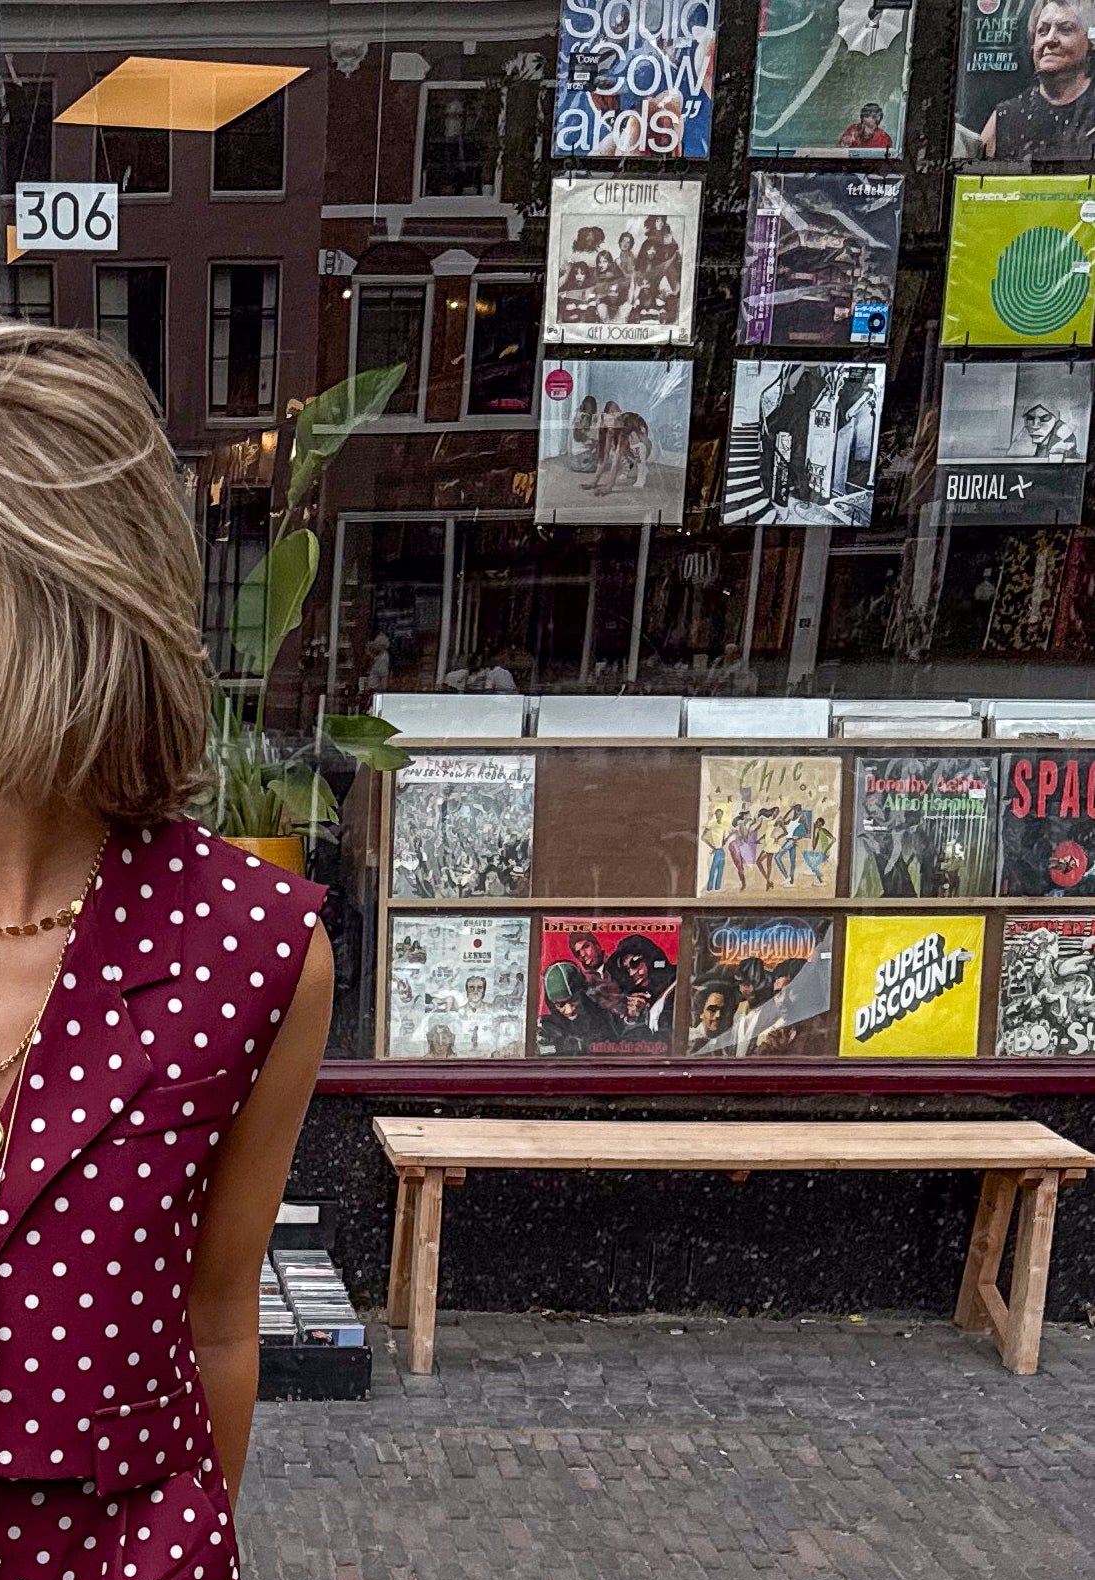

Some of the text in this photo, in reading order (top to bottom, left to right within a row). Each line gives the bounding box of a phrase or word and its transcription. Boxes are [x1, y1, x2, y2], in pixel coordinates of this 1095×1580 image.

[23, 191, 112, 241] 306
[594, 182, 658, 212] CHEYENNE
[946, 474, 1007, 500] BURIAL
[545, 923, 676, 932] black moon
[874, 932, 945, 996] SUPER
[855, 948, 966, 1042] DISCOUNT
